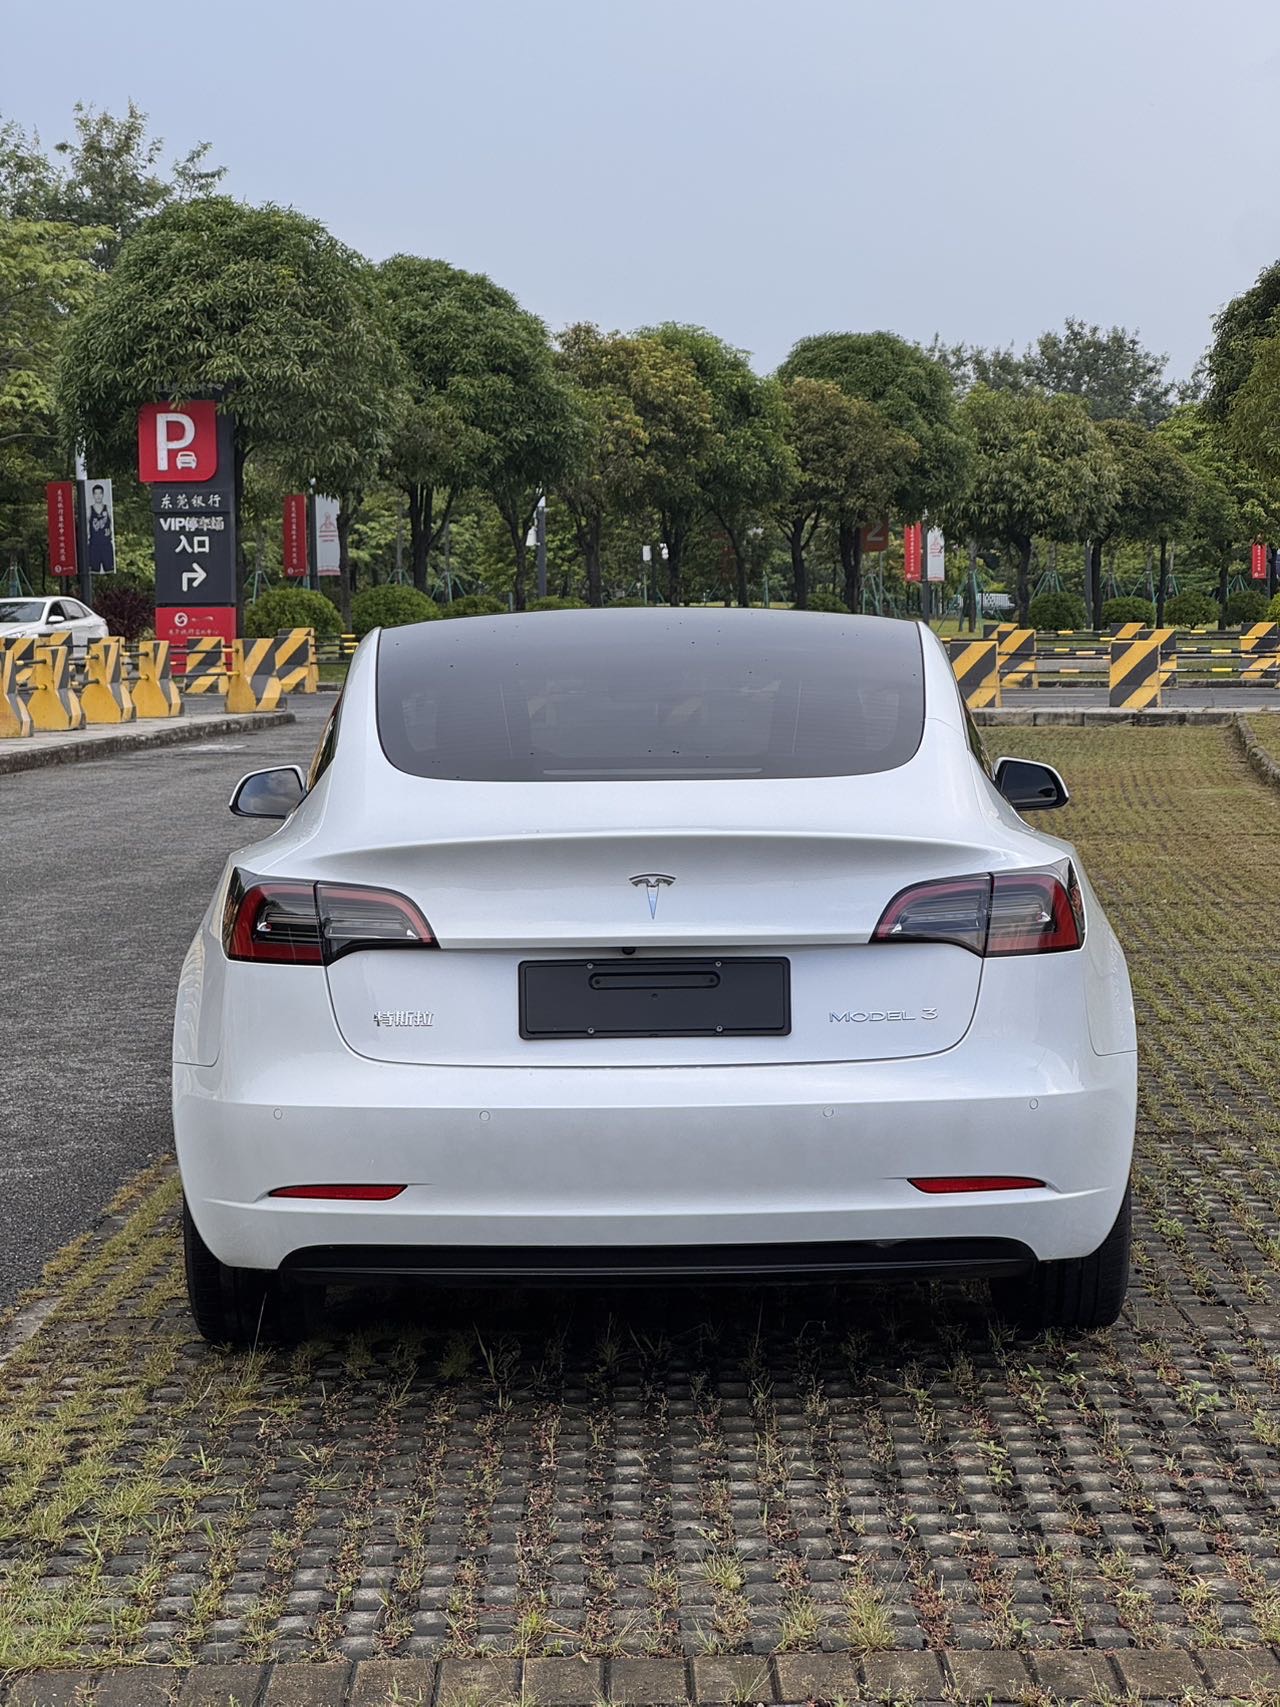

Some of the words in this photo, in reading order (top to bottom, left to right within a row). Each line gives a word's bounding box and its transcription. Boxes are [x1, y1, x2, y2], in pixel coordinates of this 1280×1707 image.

[156, 413, 195, 471] P
[161, 493, 221, 510] 东莞银行
[160, 516, 225, 532] VIP停车场
[175, 534, 210, 553] 入口
[373, 1011, 433, 1027] 特斯拉
[829, 1010, 916, 1022] MODEL
[921, 1007, 938, 1020] 3
